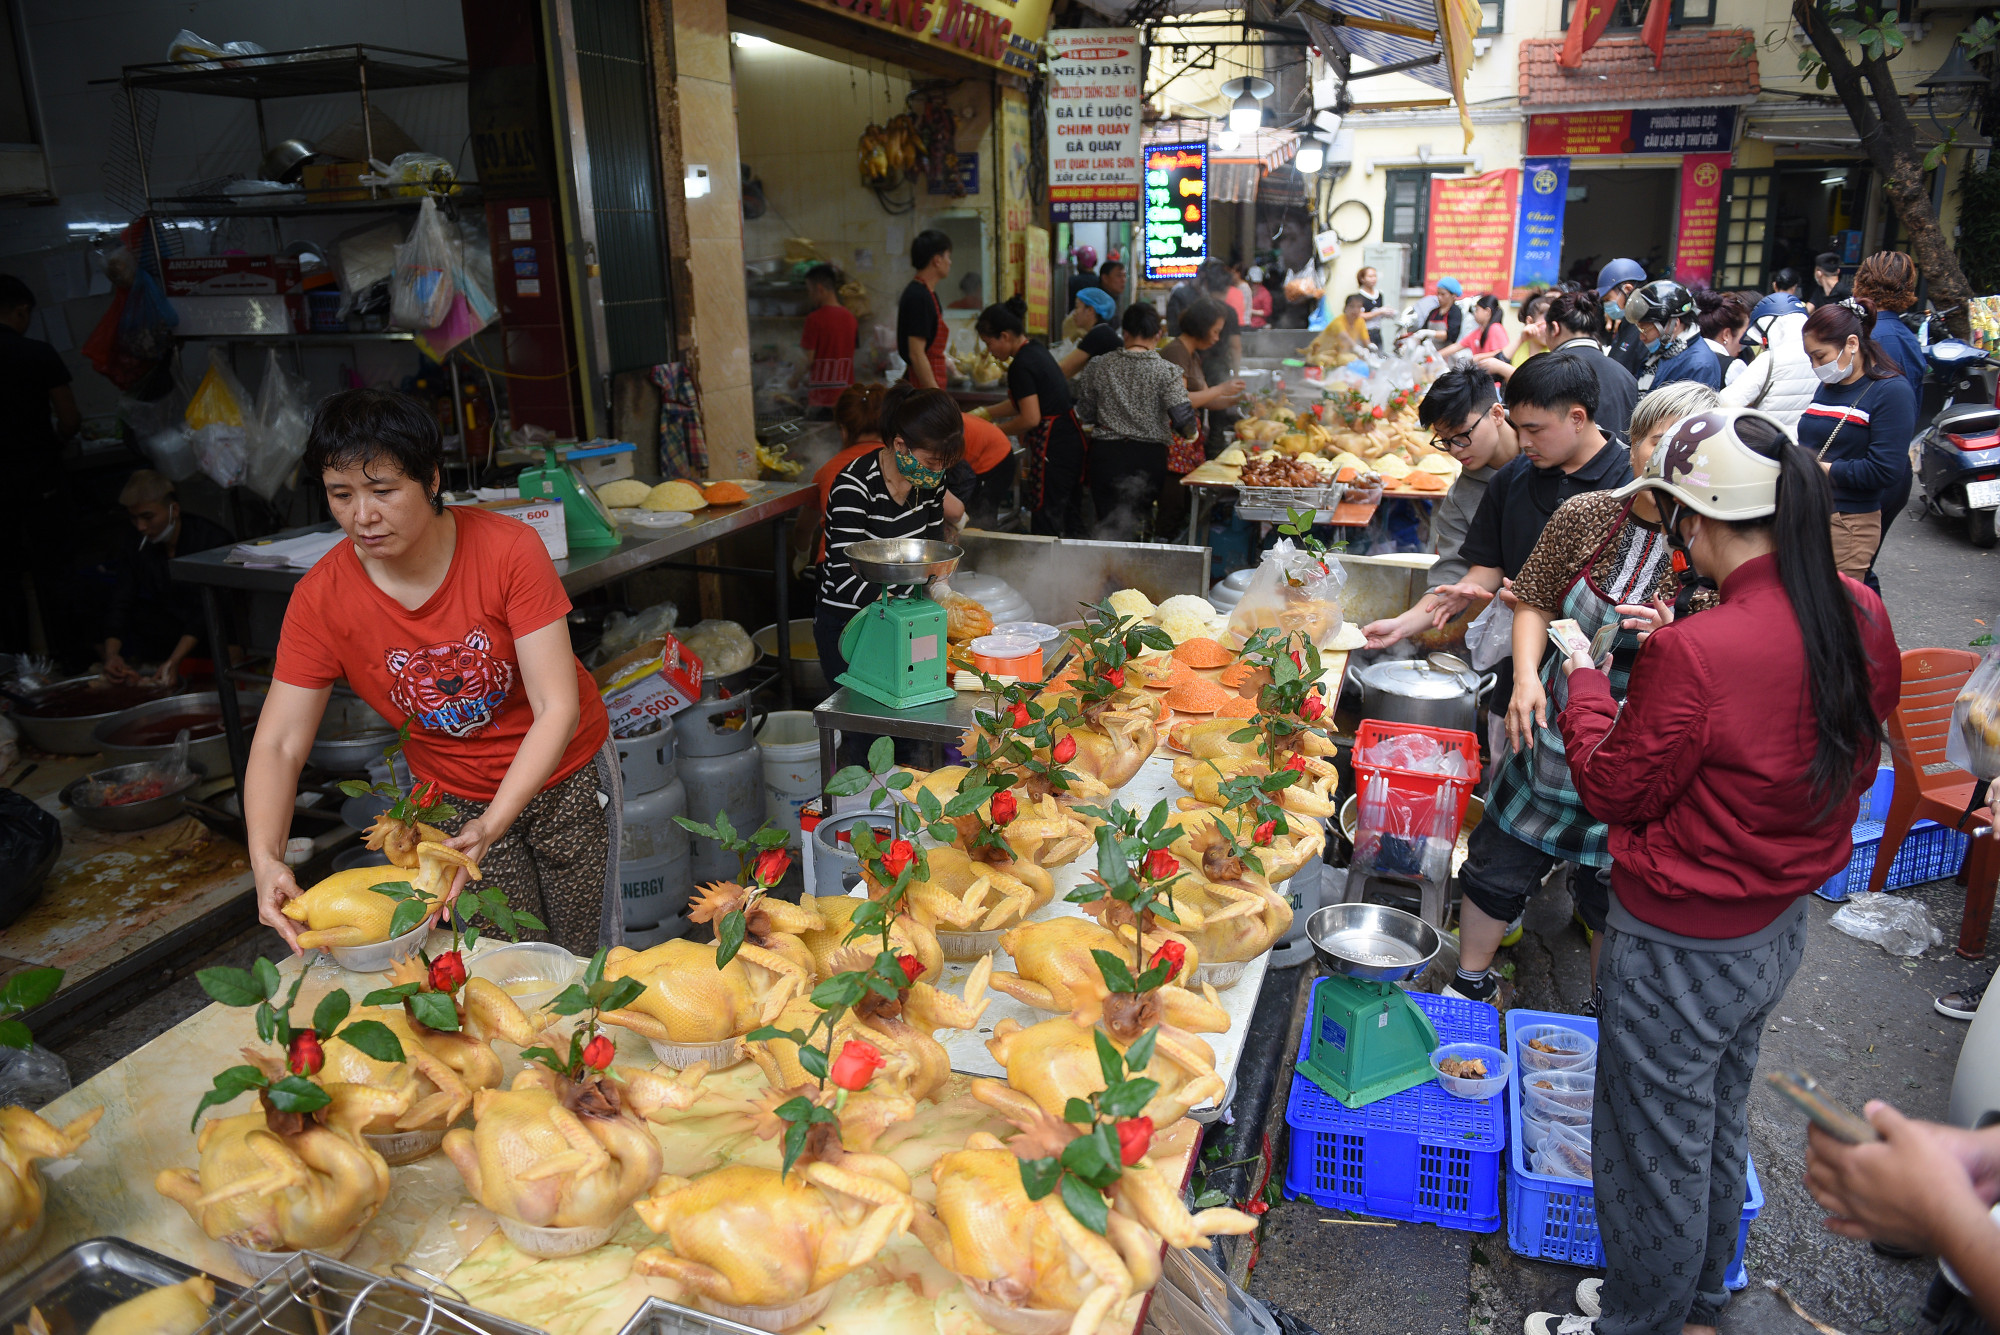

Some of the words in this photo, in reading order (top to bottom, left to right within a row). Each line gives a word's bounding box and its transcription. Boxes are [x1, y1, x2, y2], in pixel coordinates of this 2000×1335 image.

[1054, 64, 1096, 77] NHẬN
[1056, 104, 1074, 118] GÀ
[1078, 102, 1093, 118] LỄ
[1098, 103, 1132, 120] LUỘC
[1057, 124, 1093, 136] CHIM
[1097, 123, 1130, 136] QUAY
[1066, 139, 1083, 152] GÀ
[1089, 140, 1121, 152] QUAY
[1069, 158, 1090, 170] QUAY
[527, 510, 549, 520] 600
[418, 691, 507, 728] KENZO
[645, 695, 679, 716] 600
